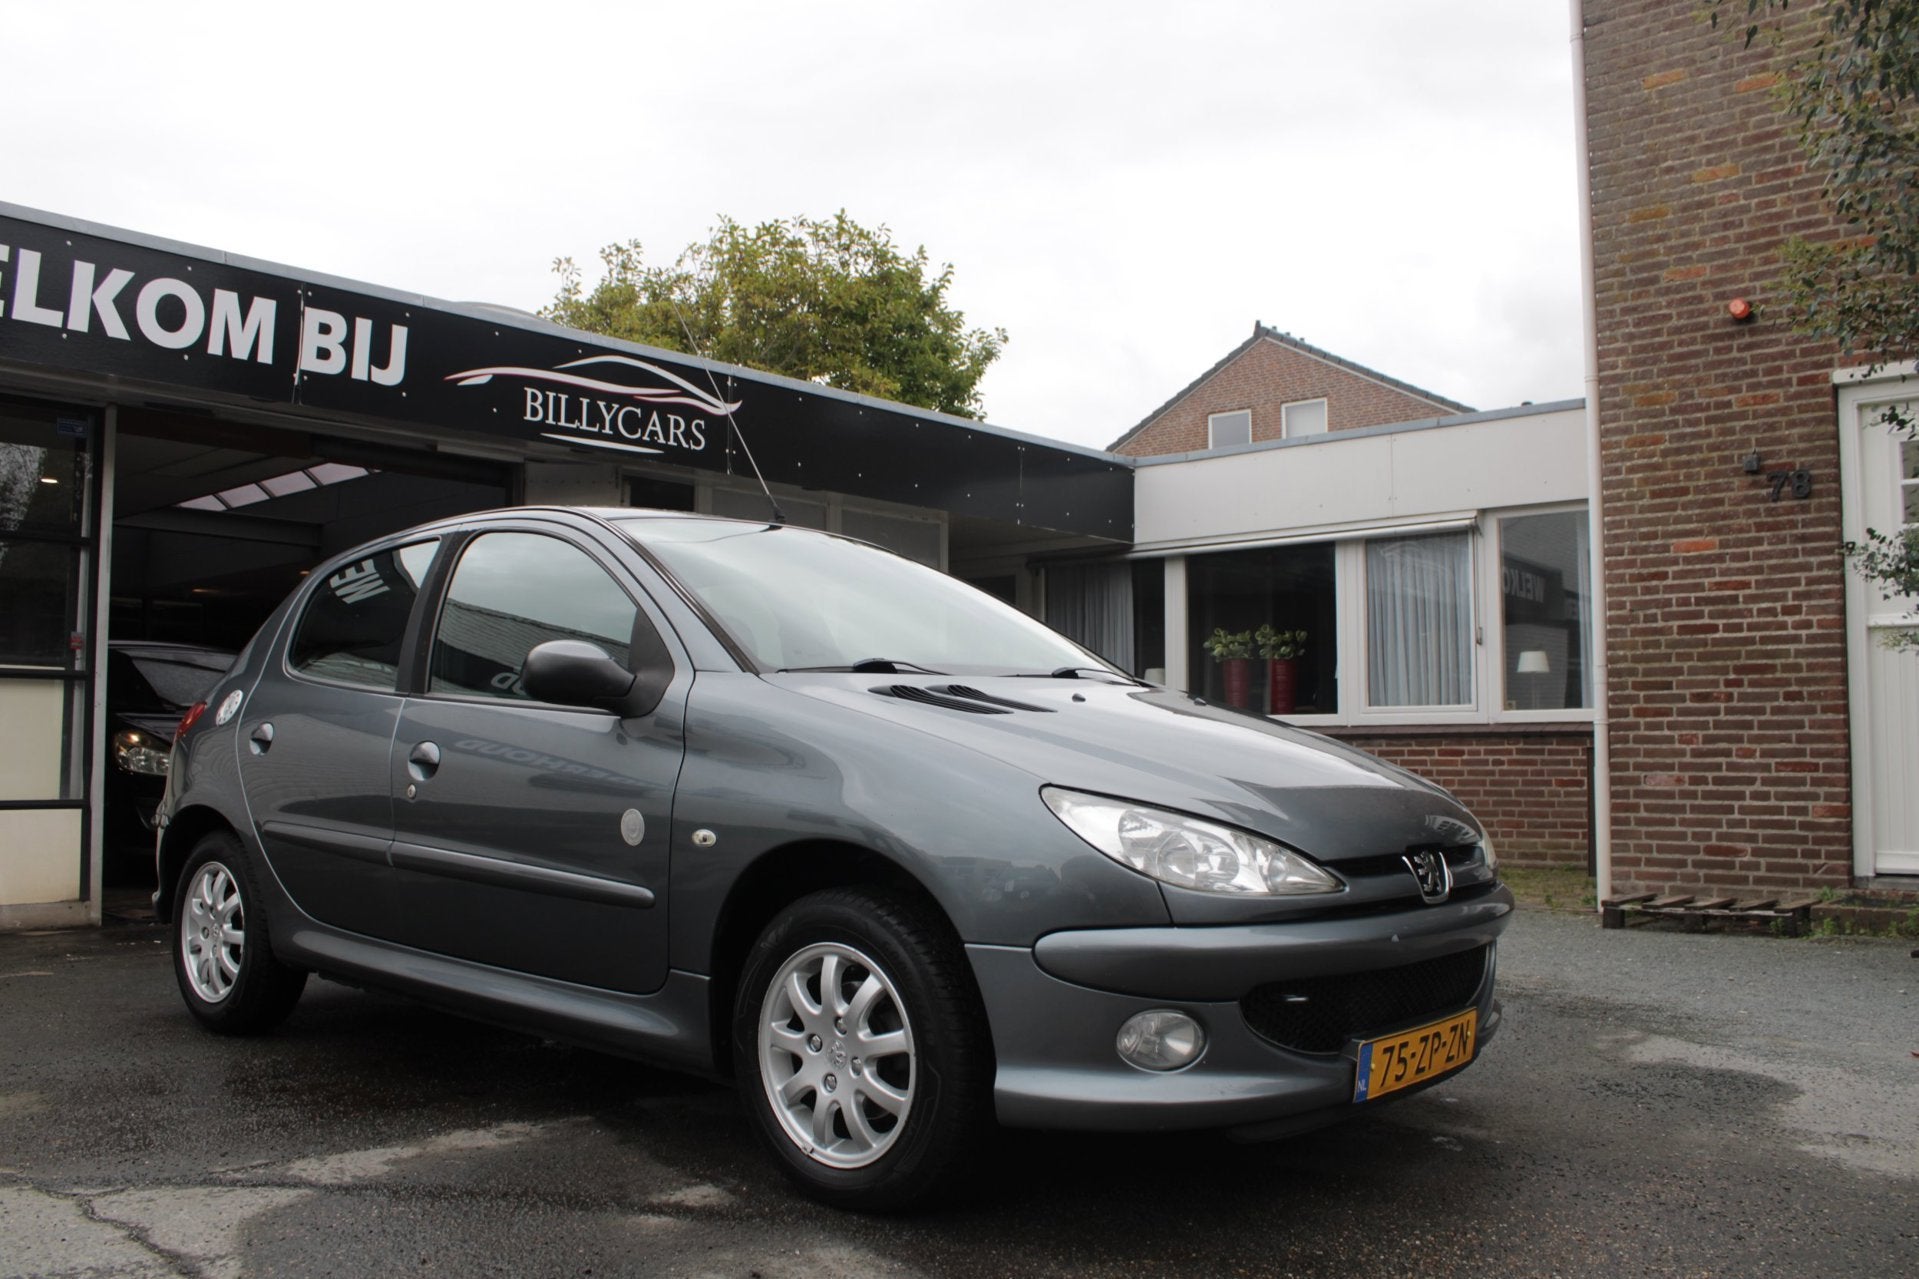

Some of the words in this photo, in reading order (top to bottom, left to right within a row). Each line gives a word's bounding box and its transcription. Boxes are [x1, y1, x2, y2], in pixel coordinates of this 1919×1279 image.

[0, 244, 276, 364] LKOM
[300, 306, 408, 386] BIJ
[523, 387, 706, 450] BILLYCARS
[1767, 469, 1811, 502] 78
[1380, 1019, 1470, 1088] 75-ZP-ZN
[1358, 1079, 1367, 1092] NL
